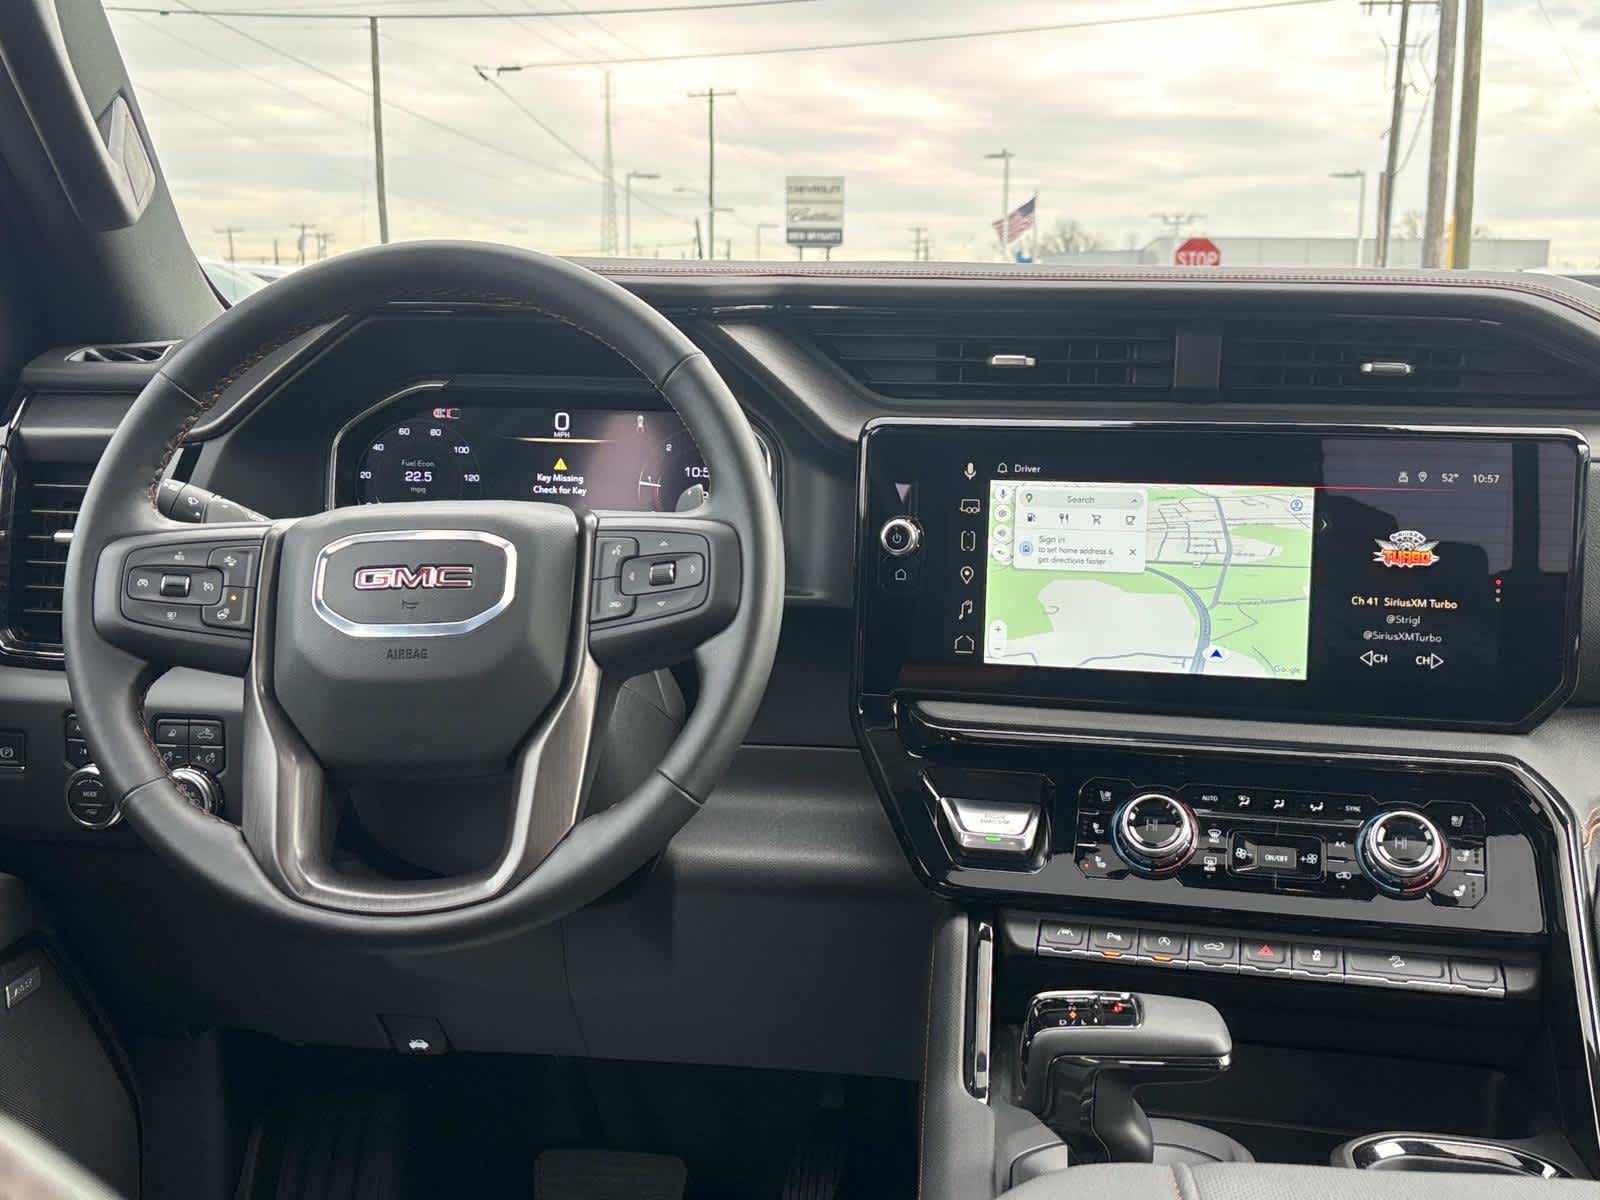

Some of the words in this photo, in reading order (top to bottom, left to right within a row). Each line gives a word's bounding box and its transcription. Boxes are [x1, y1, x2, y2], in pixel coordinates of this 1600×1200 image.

[1178, 251, 1217, 266] STOP
[398, 427, 410, 436] 60
[429, 428, 442, 437] 80
[553, 431, 570, 439] MPH
[372, 443, 385, 452] 40
[453, 446, 470, 455] 100
[1014, 464, 1041, 473] Driver
[359, 471, 372, 480] 20
[463, 474, 480, 482] 120
[404, 471, 433, 482] 22.5
[536, 474, 552, 484] Key
[553, 473, 584, 484] Missing
[1472, 473, 1500, 484] 10:57
[410, 487, 426, 495] mpg
[532, 485, 558, 495] Check
[559, 486, 571, 495] for
[572, 486, 588, 497] Key
[1067, 495, 1095, 504] Search
[1039, 535, 1058, 546] Sign
[1059, 547, 1078, 555] home
[1079, 547, 1107, 556] address
[1038, 556, 1049, 565] get
[1050, 556, 1085, 565] directions
[1086, 557, 1106, 566] faster
[1384, 550, 1433, 566] TURBO
[354, 565, 473, 590] GMC
[1351, 595, 1366, 606] Ch
[1367, 596, 1378, 606] 41
[1384, 596, 1427, 608] SiriusXM
[1430, 599, 1458, 609] Turbo
[1362, 631, 1442, 643] @SiriusXMTurbo
[385, 648, 429, 660] AIRBAG
[1373, 653, 1388, 664] CH
[1415, 655, 1431, 666] CH
[1274, 665, 1301, 675] Google
[1345, 805, 1361, 813] SYNC
[1264, 854, 1288, 863] ON/OFF
